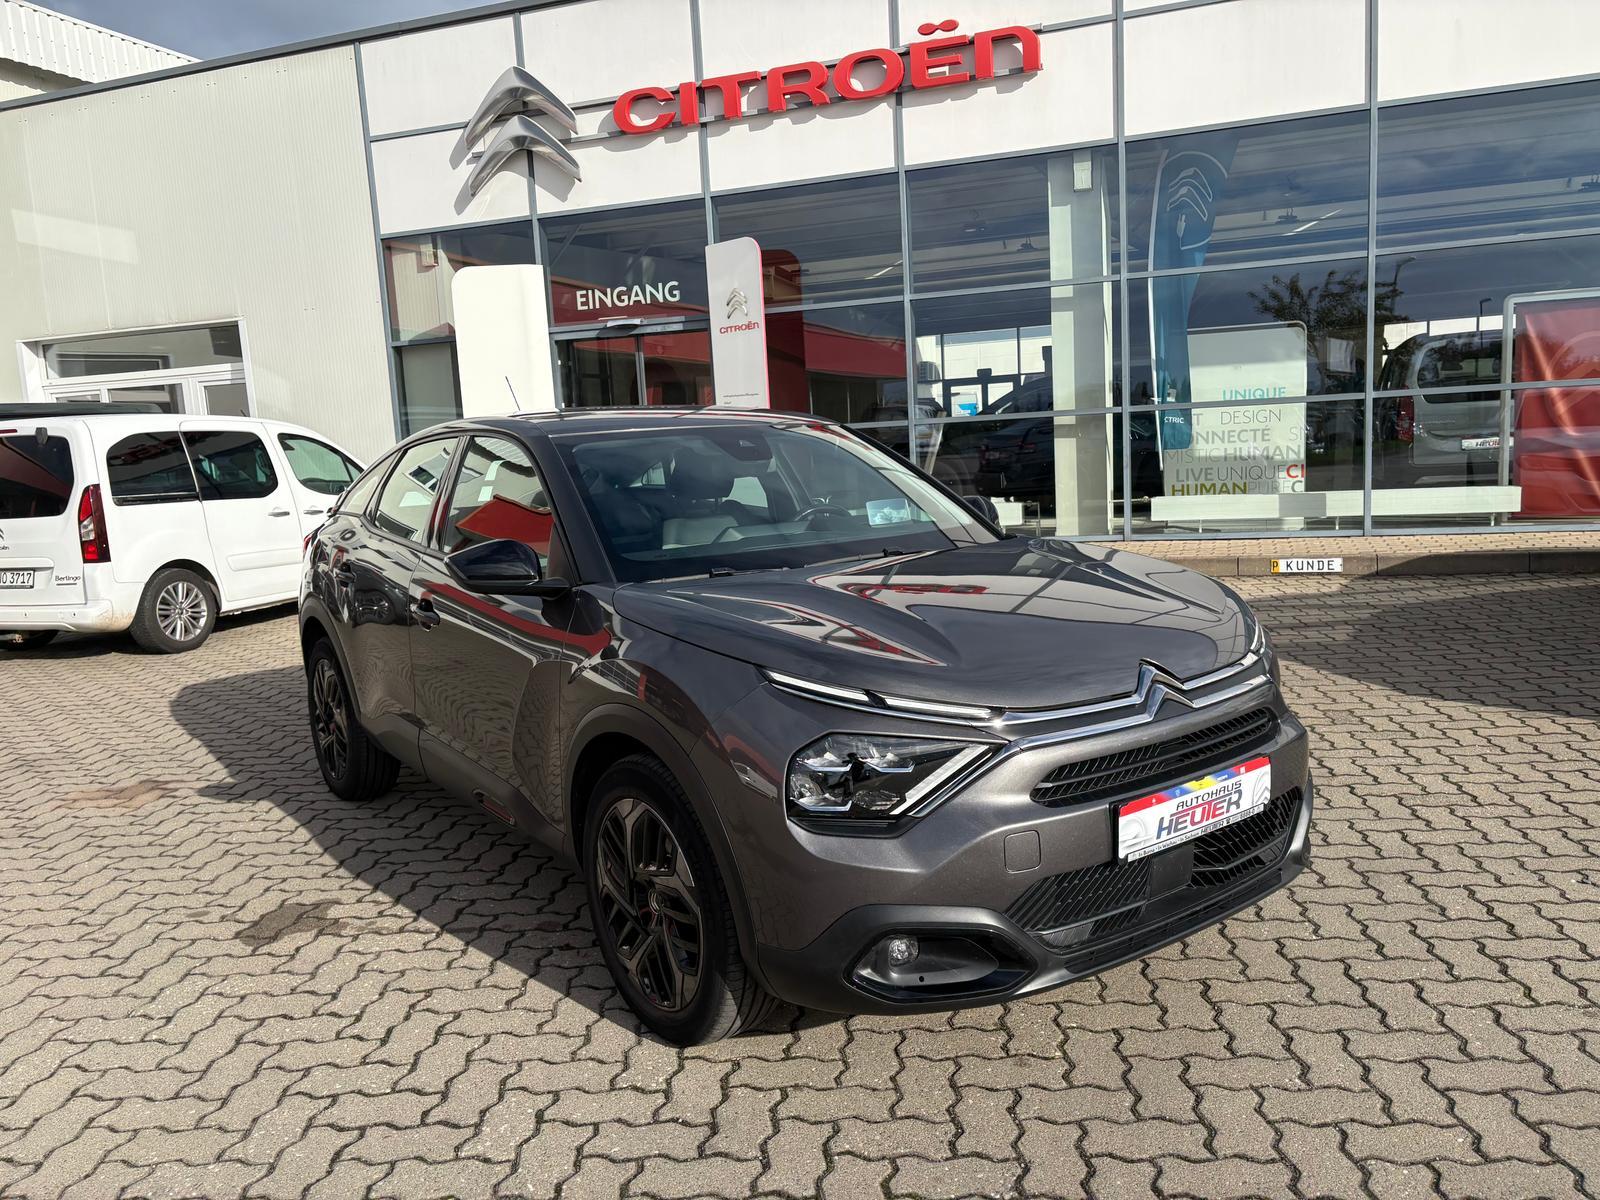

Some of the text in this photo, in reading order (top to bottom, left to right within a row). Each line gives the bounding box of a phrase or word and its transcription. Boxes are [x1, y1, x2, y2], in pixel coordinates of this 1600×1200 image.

[575, 280, 681, 311] EINGANG
[1222, 386, 1287, 401] UNIQUE
[1220, 408, 1282, 426] DESIGN
[1223, 444, 1301, 462] HUMAN
[1175, 466, 1214, 483] LIVE
[1217, 464, 1287, 482] UNIQUE
[1171, 481, 1248, 497] HUMAN
[1272, 559, 1335, 572] P KUNDE
[9, 572, 32, 584] 3717
[54, 574, 82, 583] Berlingo
[1175, 779, 1243, 811] AUTOHAUS
[1155, 788, 1244, 840] HEUTER
